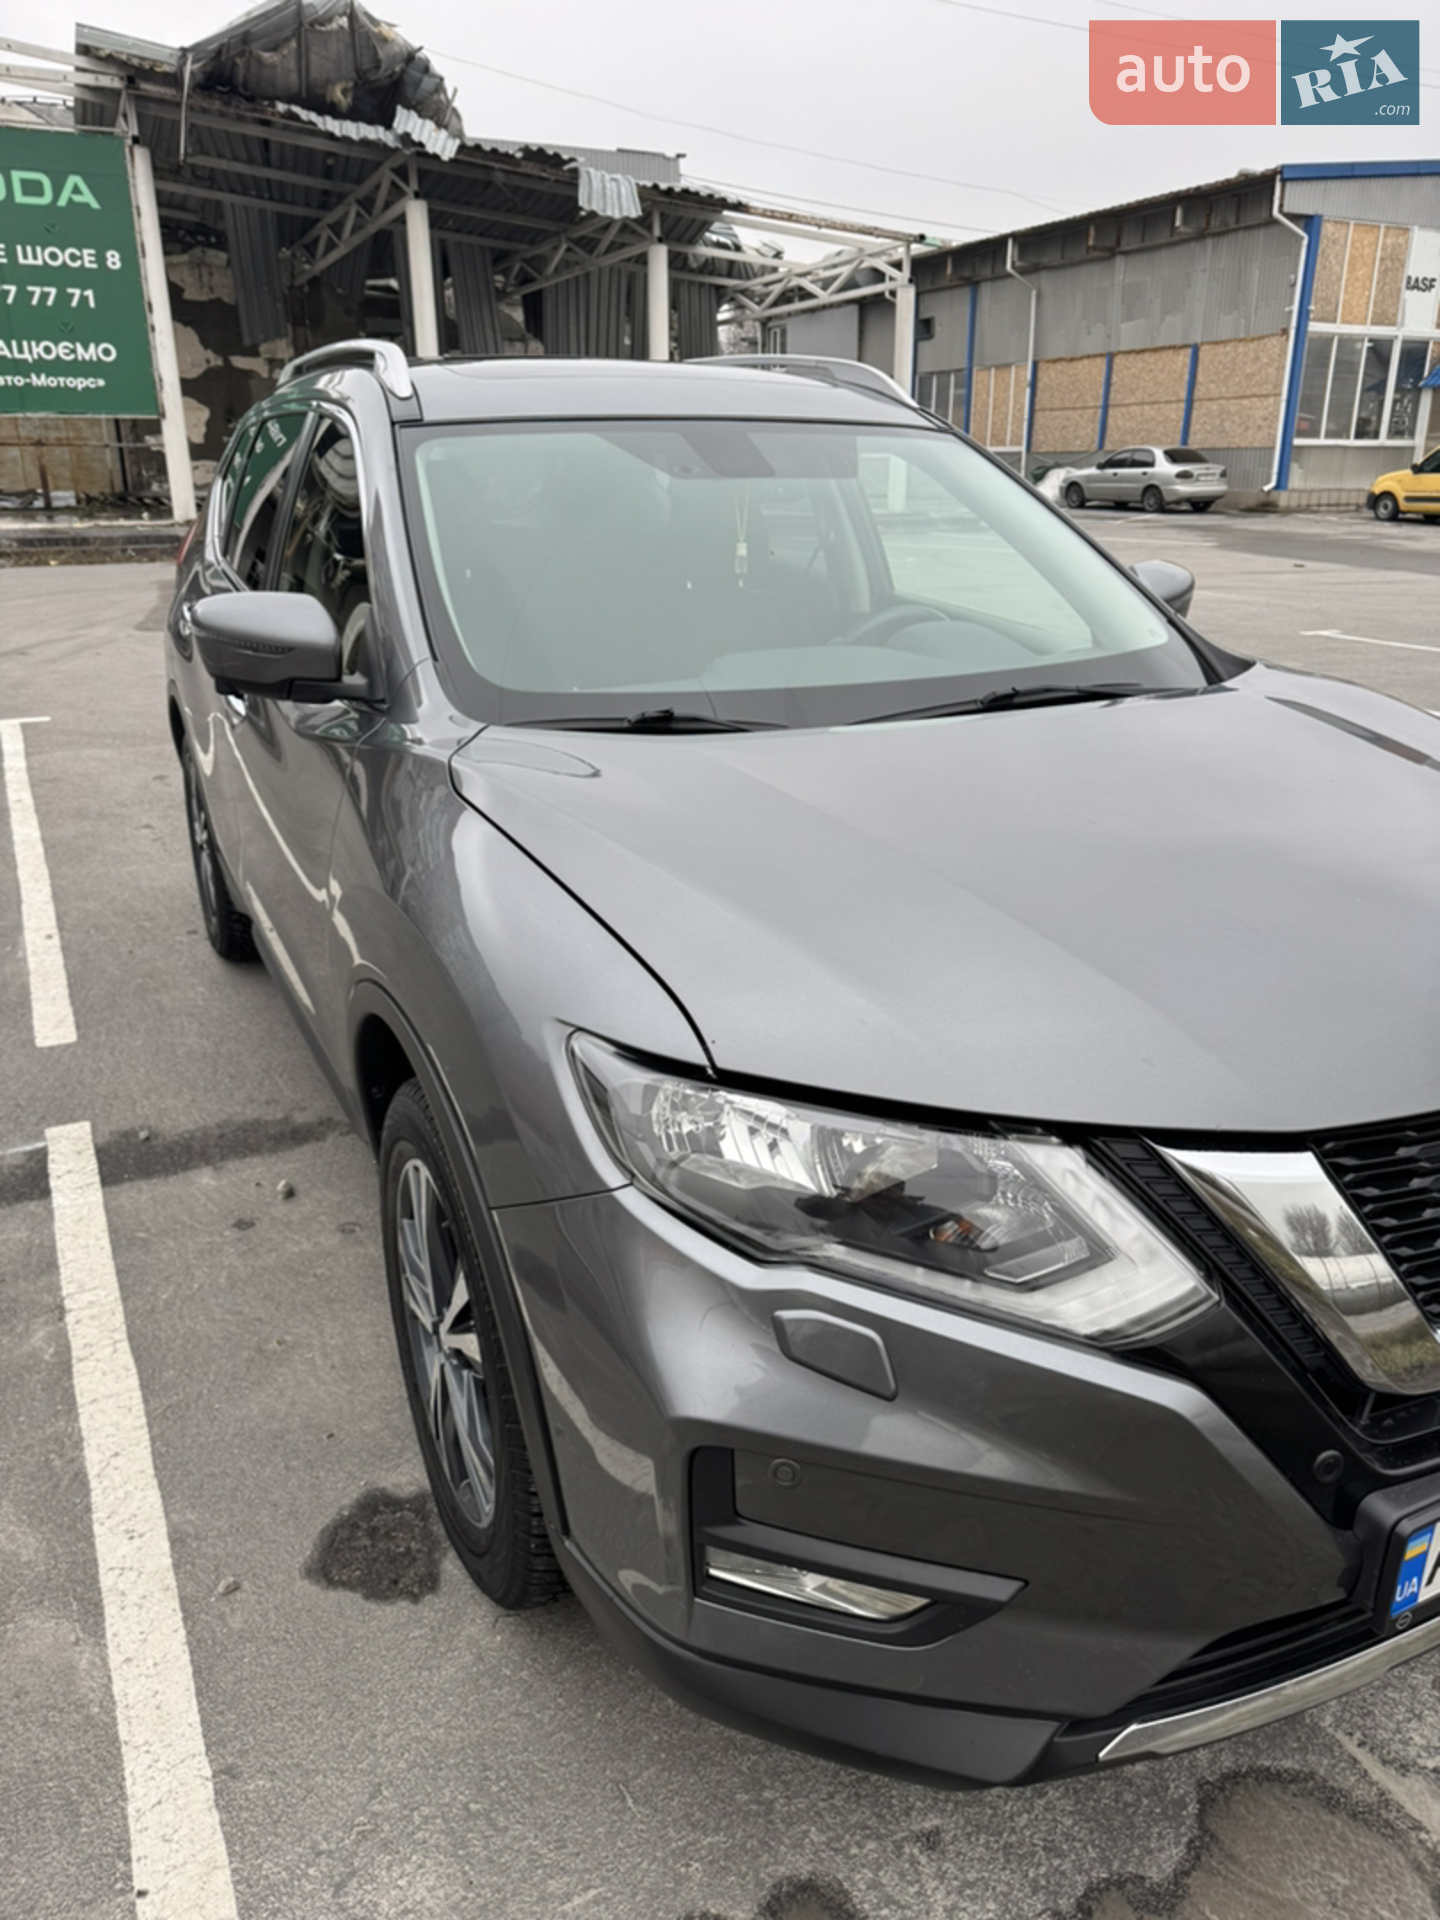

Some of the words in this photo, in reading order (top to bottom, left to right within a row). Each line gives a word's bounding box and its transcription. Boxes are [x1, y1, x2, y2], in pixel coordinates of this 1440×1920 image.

[0, 169, 101, 210] DA
[16, 244, 98, 269] ШОСЕ
[105, 249, 122, 270] 8
[26, 285, 57, 307] 77
[66, 287, 96, 309] 71
[1395, 1577, 1418, 1602] UA
